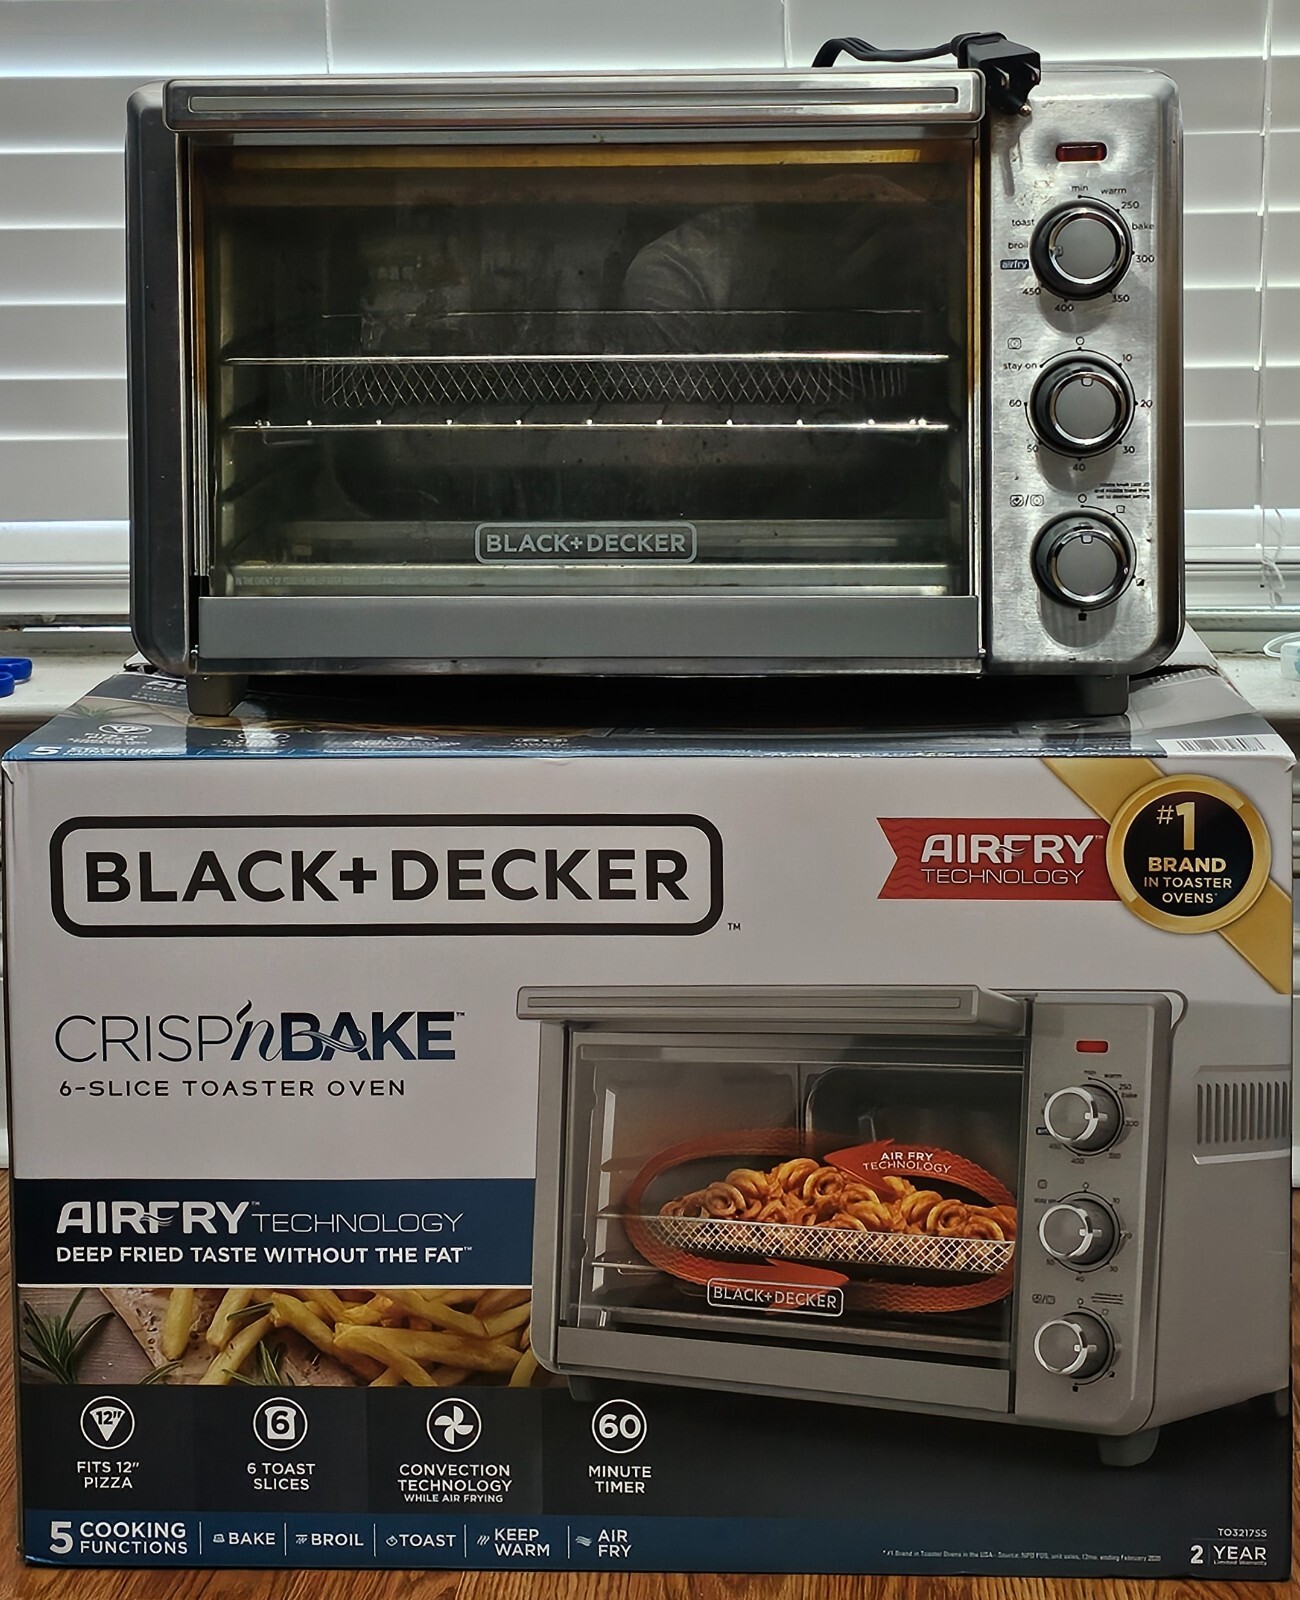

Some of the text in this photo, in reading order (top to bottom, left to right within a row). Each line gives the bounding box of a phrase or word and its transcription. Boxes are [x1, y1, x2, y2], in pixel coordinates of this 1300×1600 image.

[1071, 184, 1089, 192] min
[1101, 186, 1127, 195] warm
[1121, 200, 1140, 210] 250
[1012, 217, 1035, 227] toast
[1132, 221, 1155, 231] bake
[1008, 241, 1028, 250] broil
[1001, 259, 1029, 270] airfry
[1136, 254, 1155, 264] 300
[1022, 286, 1042, 296] 450
[1112, 293, 1130, 303] 350
[1055, 303, 1075, 313] 400
[1121, 353, 1133, 363] 10
[1003, 362, 1038, 371] stay on
[1008, 399, 1022, 408] 60
[1140, 399, 1154, 408] 20
[1026, 444, 1040, 453] 50
[1122, 445, 1136, 455] 30
[1072, 463, 1086, 473] 40
[486, 533, 686, 553] BLACK+DECKER
[1156, 801, 1196, 851] #1
[1148, 856, 1227, 874] BRAND
[85, 848, 690, 903] BLACK+DECKER
[921, 868, 1084, 885] TECHNOLOGY
[1143, 876, 1233, 889] IN TOASTER
[59, 1079, 405, 1097] 6-SLICE TOASTER OVEN
[880, 1151, 934, 1161] AIR FRY
[862, 1160, 952, 1174] TECHNOLOGY
[251, 1213, 464, 1232] TECHNOLOGY
[56, 1246, 113, 1263] DEEP
[120, 1246, 184, 1263] FRIED
[190, 1246, 258, 1263] TASTE
[263, 1247, 369, 1264] WITHOUT
[374, 1247, 418, 1264] THE
[713, 1285, 838, 1309] BLACK+DECKER
[270, 1410, 290, 1435] 6
[599, 1413, 642, 1439] 60
[76, 1461, 112, 1474] FITS
[247, 1462, 316, 1475] 6 TOAST
[399, 1463, 511, 1477] CONVECTION
[589, 1465, 652, 1478] MINUTE
[84, 1476, 133, 1490] PIZZA
[253, 1478, 310, 1491] SLICES
[398, 1479, 513, 1493] TECHNOLOGY
[595, 1481, 646, 1494] TIMER
[404, 1493, 504, 1503] WHILE AIR FRYING
[79, 1521, 187, 1539] COOKING
[494, 1527, 540, 1542] KEEP
[598, 1529, 628, 1543] AIR
[1217, 1527, 1268, 1538] TO3217SS
[49, 1520, 74, 1555] 5
[229, 1531, 276, 1546] BAKE
[311, 1532, 364, 1547] BROIL
[399, 1533, 457, 1548] TOAST
[80, 1540, 188, 1555] FUNCTIONS
[494, 1543, 550, 1557] WARM
[598, 1544, 632, 1558] FRY
[1190, 1544, 1204, 1564] 2
[1213, 1545, 1267, 1560] YEAR
